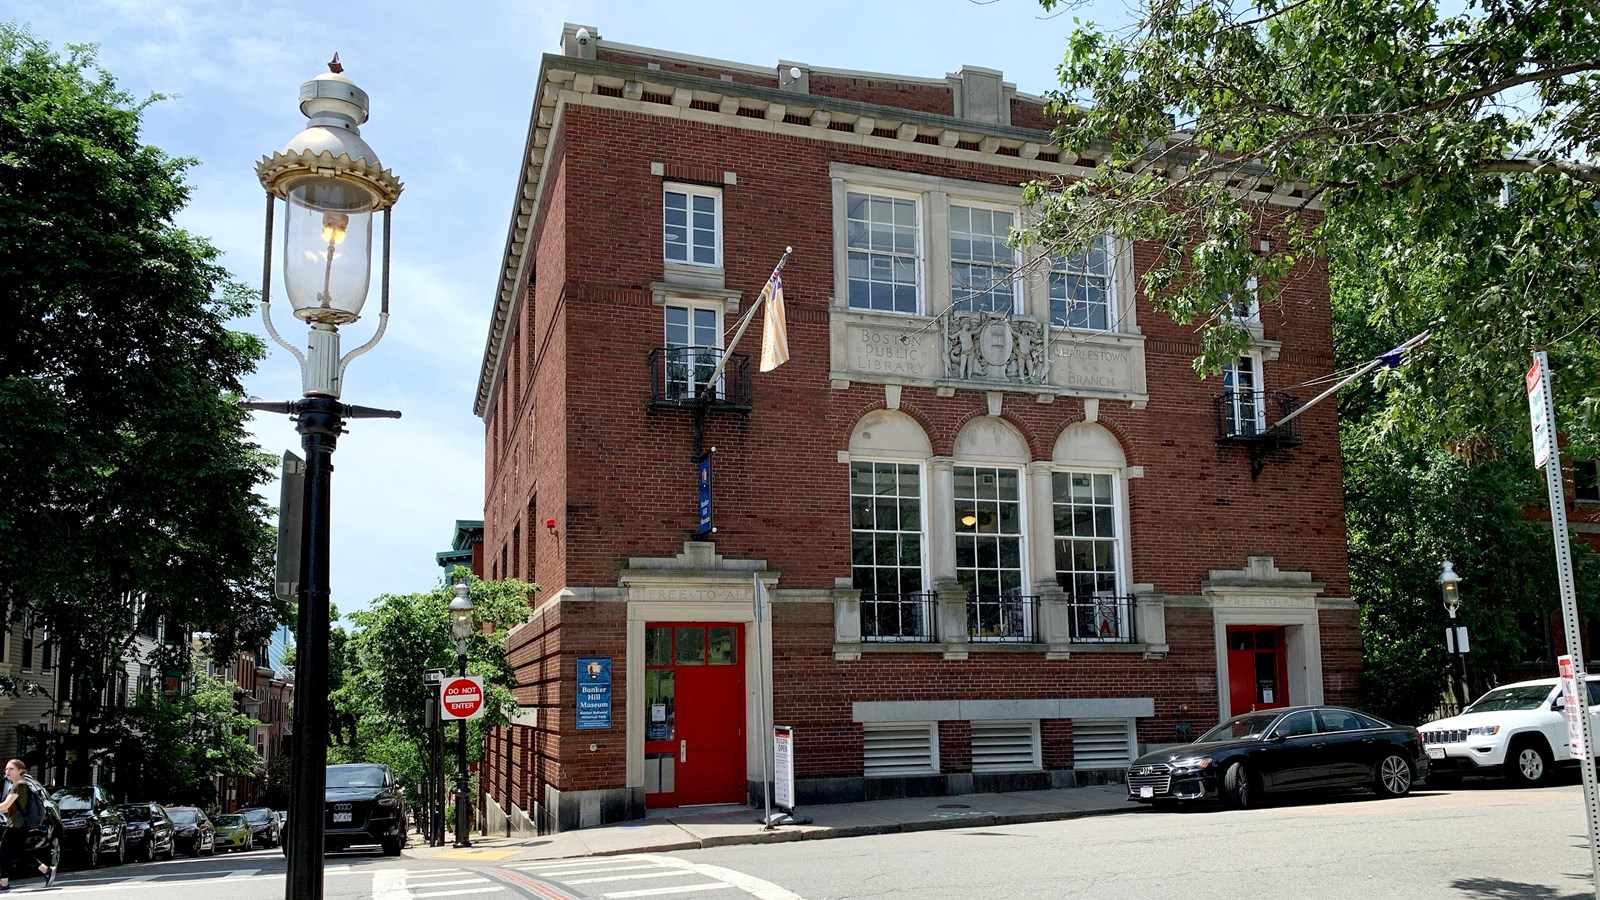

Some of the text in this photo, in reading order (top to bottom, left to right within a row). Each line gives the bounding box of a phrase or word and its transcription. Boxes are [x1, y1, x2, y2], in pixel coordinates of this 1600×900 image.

[861, 329, 921, 346] BOSTON
[866, 344, 918, 360] PUBLIC
[1053, 345, 1128, 362] CHARLESTOWN
[857, 357, 925, 374] LIBRARY
[1068, 371, 1115, 387] BRANCH
[587, 693, 601, 701] Hill
